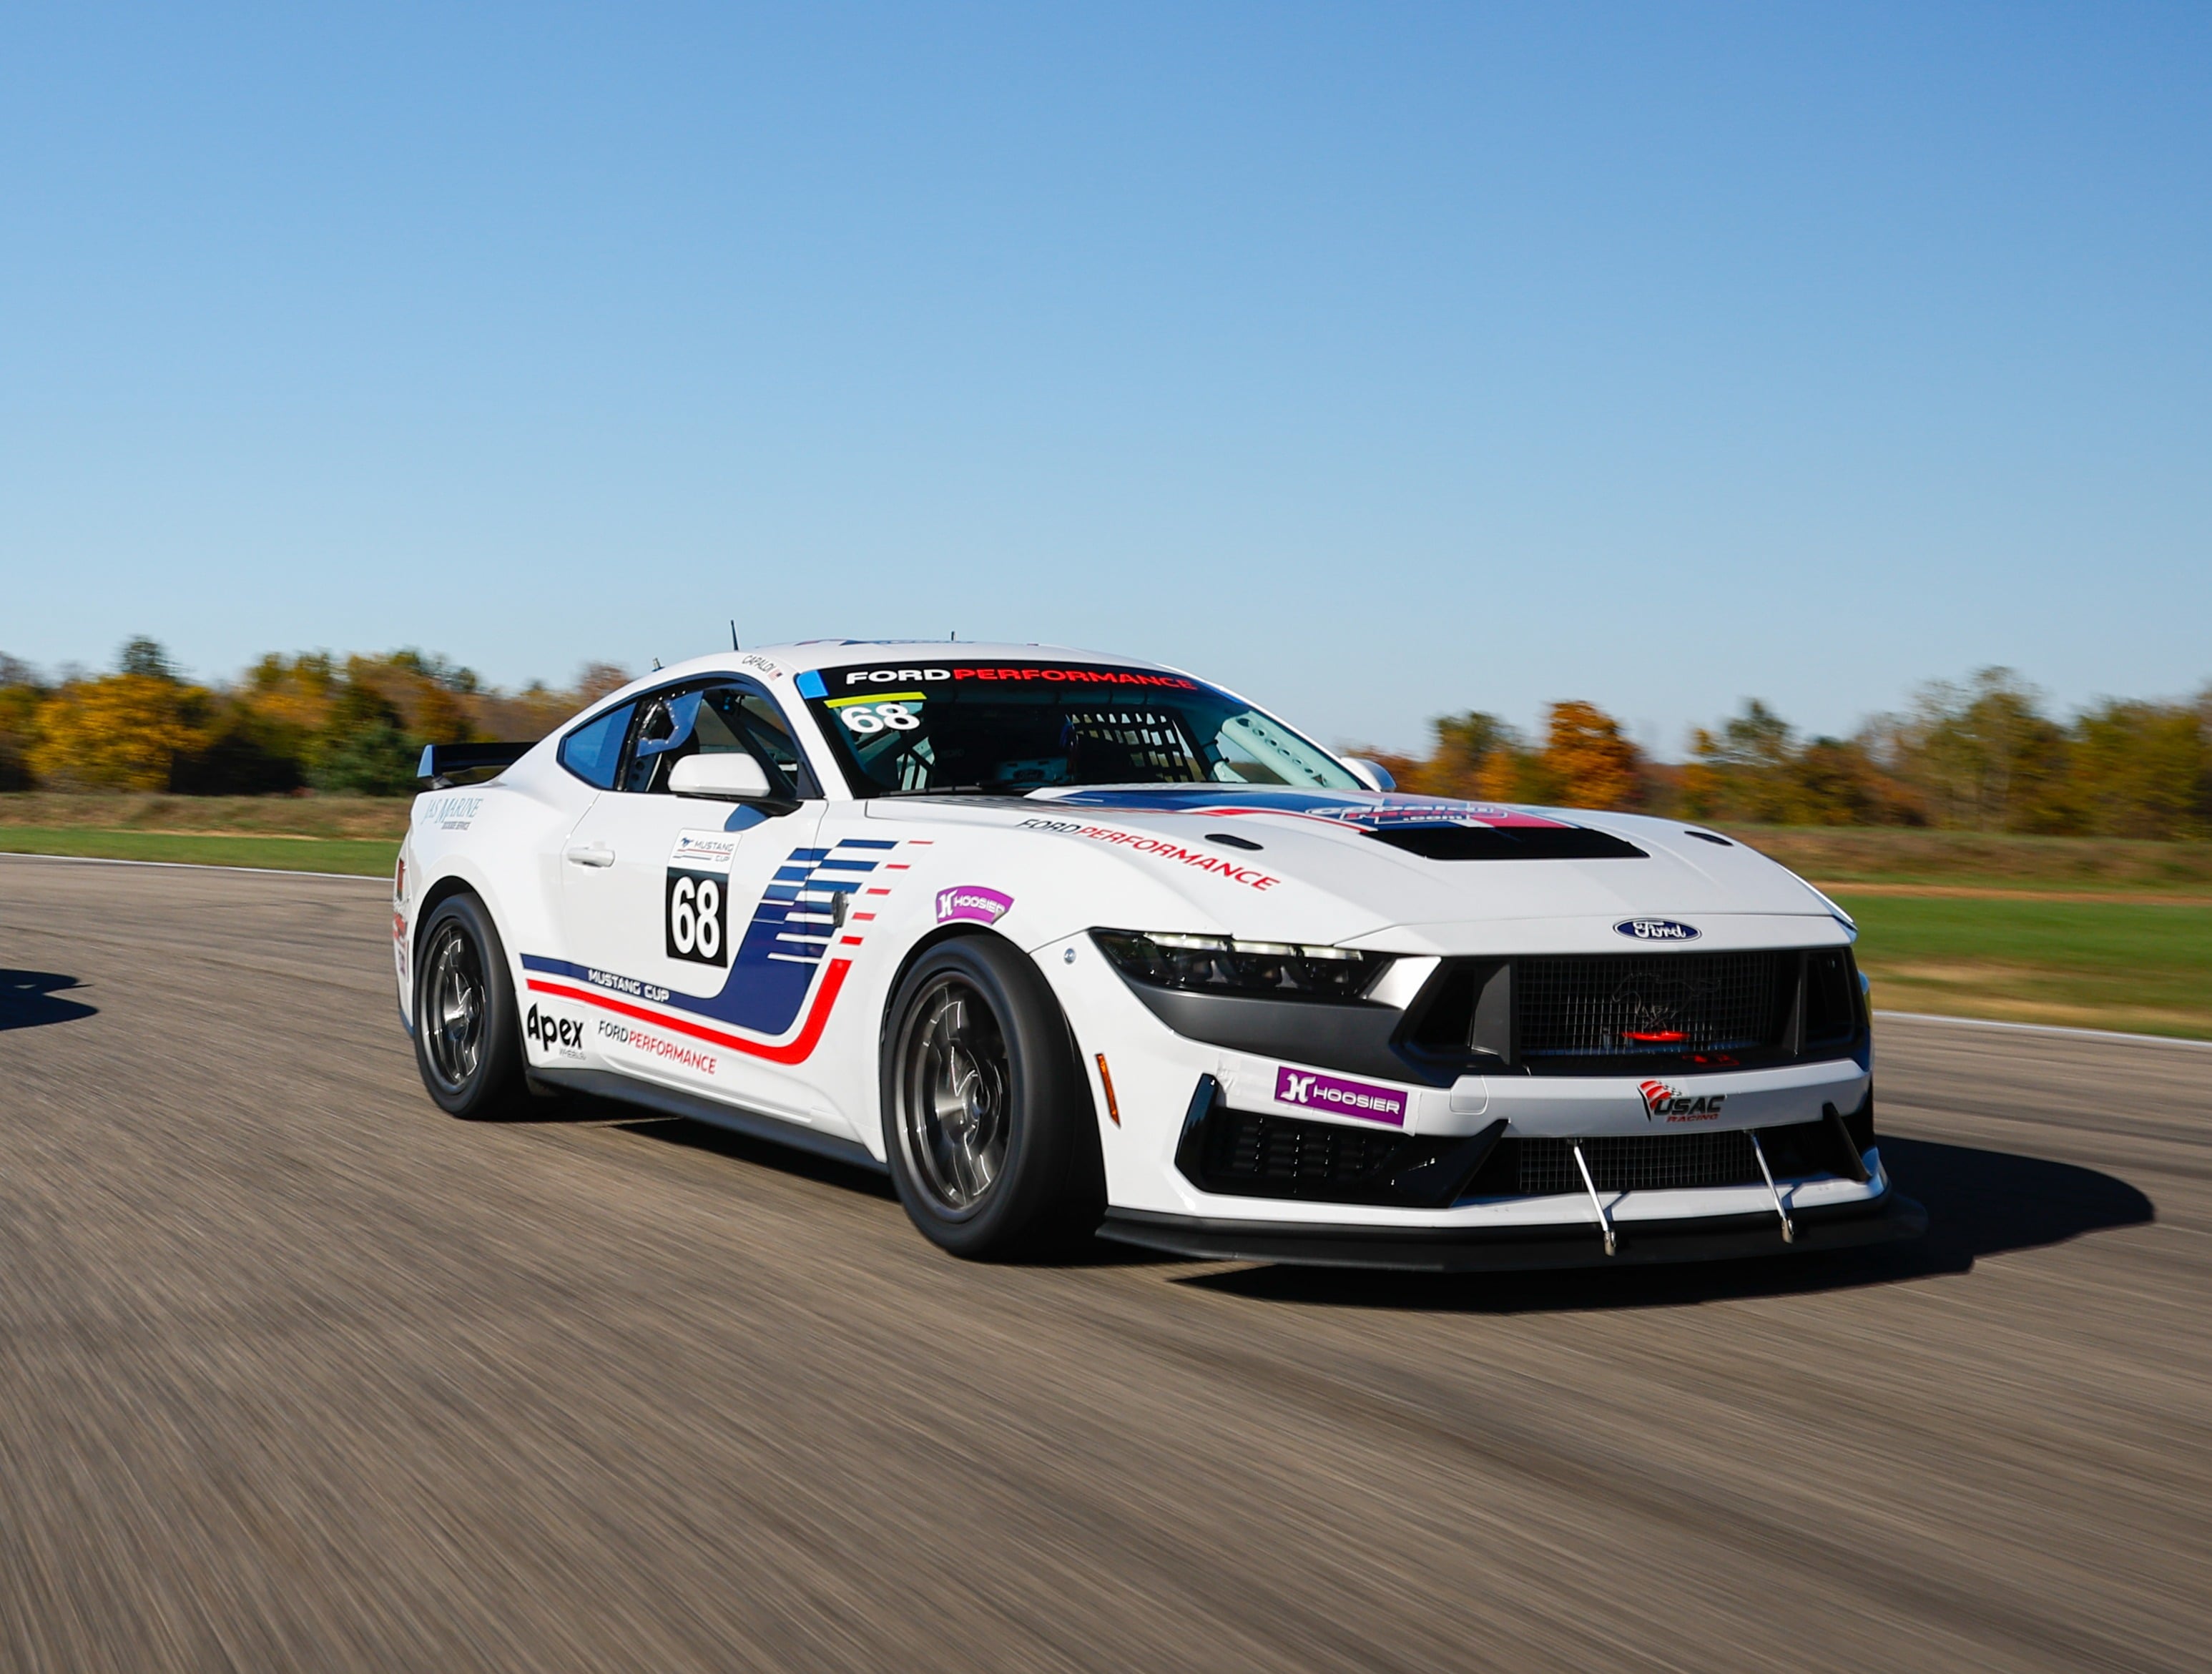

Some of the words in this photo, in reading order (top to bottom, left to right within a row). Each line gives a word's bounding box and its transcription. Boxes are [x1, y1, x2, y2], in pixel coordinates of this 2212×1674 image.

[846, 669, 1198, 691] FORDPERFORMANCE
[840, 704, 920, 733] 68
[433, 797, 483, 824] MARINE
[694, 840, 734, 852] MUSTANG
[1016, 819, 1280, 891] FORDPERFORMANCE
[672, 876, 720, 958] 68
[1633, 921, 1686, 937] Ford
[588, 969, 642, 995] MUSTANG
[644, 982, 670, 1003] CUP
[527, 1001, 584, 1052] Apex
[598, 1019, 717, 1075] FORDPERFORMANCE
[1313, 1084, 1400, 1115] HOOSIER
[1654, 1095, 1726, 1116] USAC
[1666, 1113, 1719, 1123] RACING
